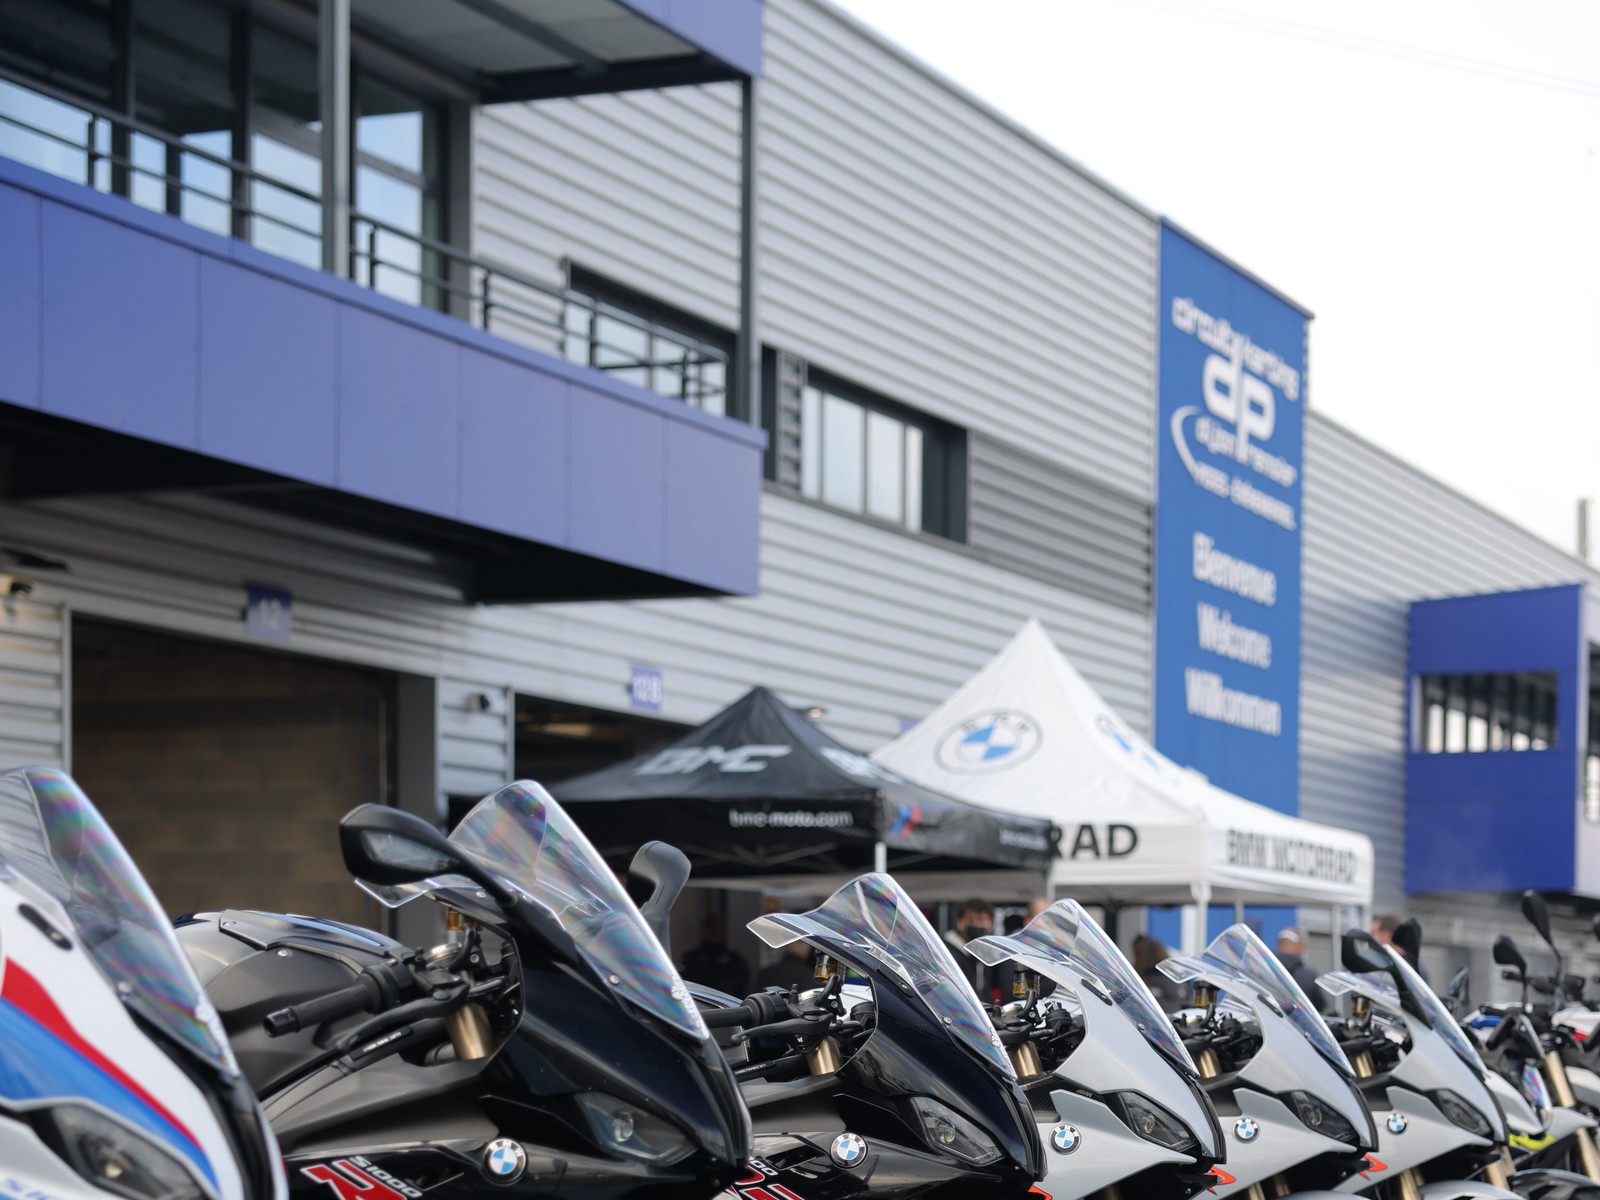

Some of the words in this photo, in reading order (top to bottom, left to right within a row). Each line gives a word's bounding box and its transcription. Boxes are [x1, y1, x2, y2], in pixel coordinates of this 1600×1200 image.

[1197, 600, 1272, 670] Welcome
[1185, 666, 1283, 737] Willkommen
[838, 1134, 866, 1148] BMW
